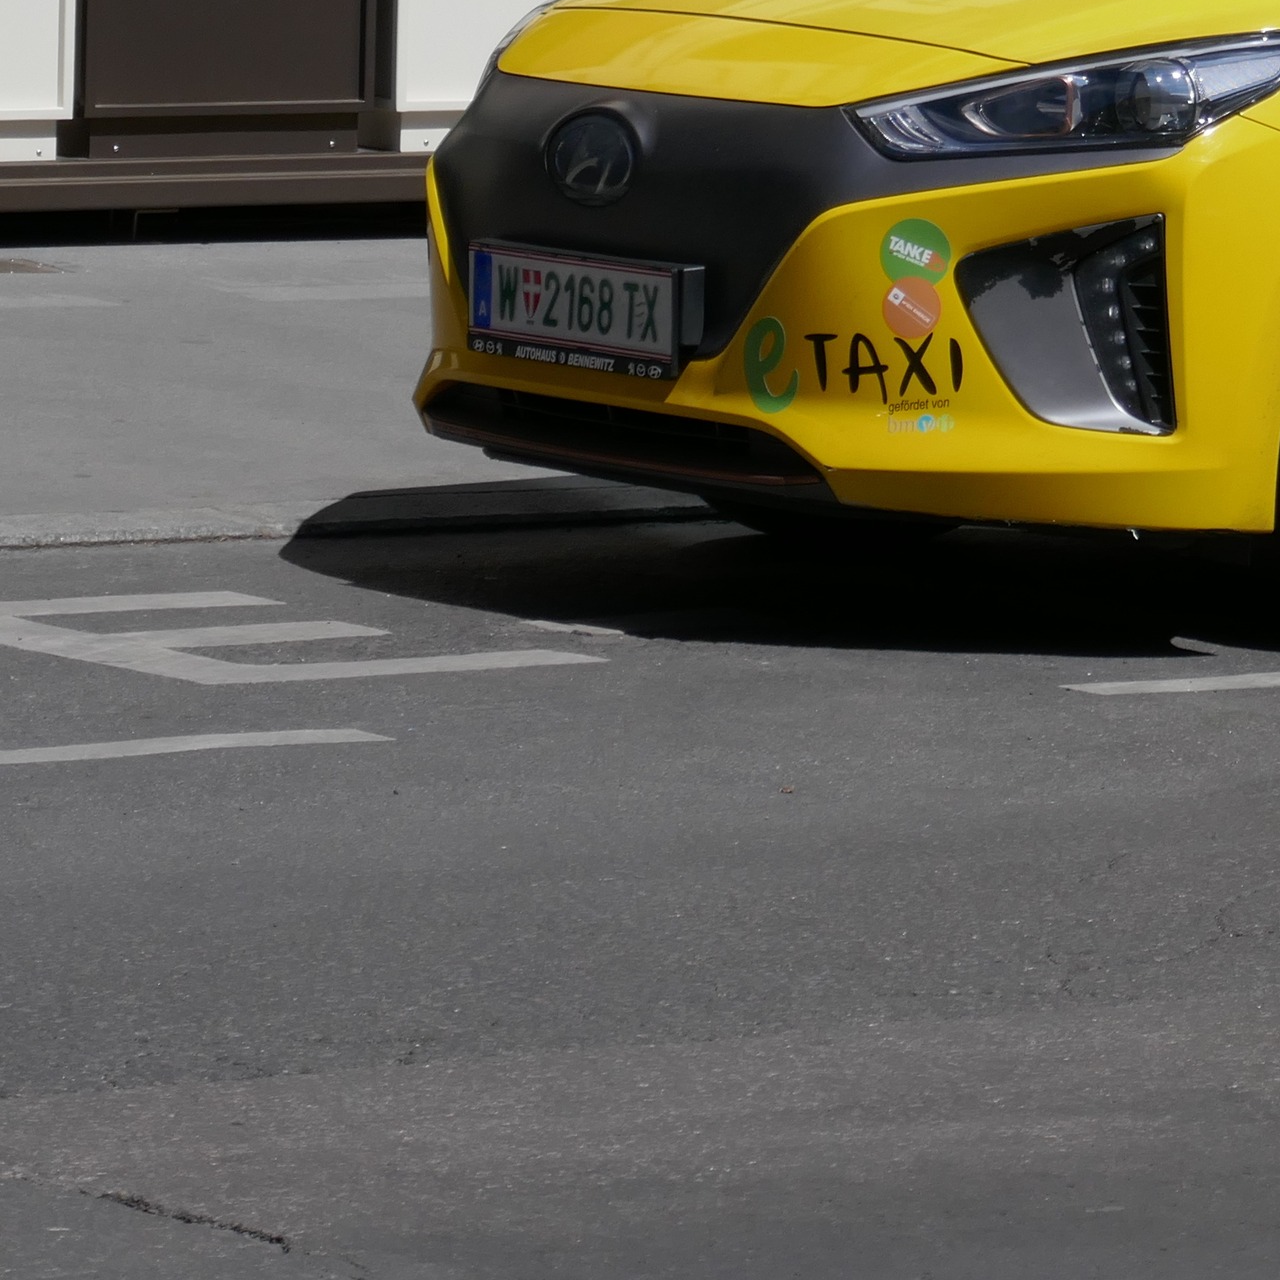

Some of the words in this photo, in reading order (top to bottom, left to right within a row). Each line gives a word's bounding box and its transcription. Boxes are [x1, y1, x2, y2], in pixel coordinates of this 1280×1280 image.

[889, 235, 934, 264] TANKE
[478, 300, 487, 317] A
[498, 264, 519, 322] W
[541, 271, 614, 336] 2168
[623, 281, 659, 343] TX
[515, 344, 557, 363] AUTOHAUS
[568, 354, 615, 372] BENNEWITZ
[888, 399, 929, 416] gefördet
[931, 398, 950, 409] von
